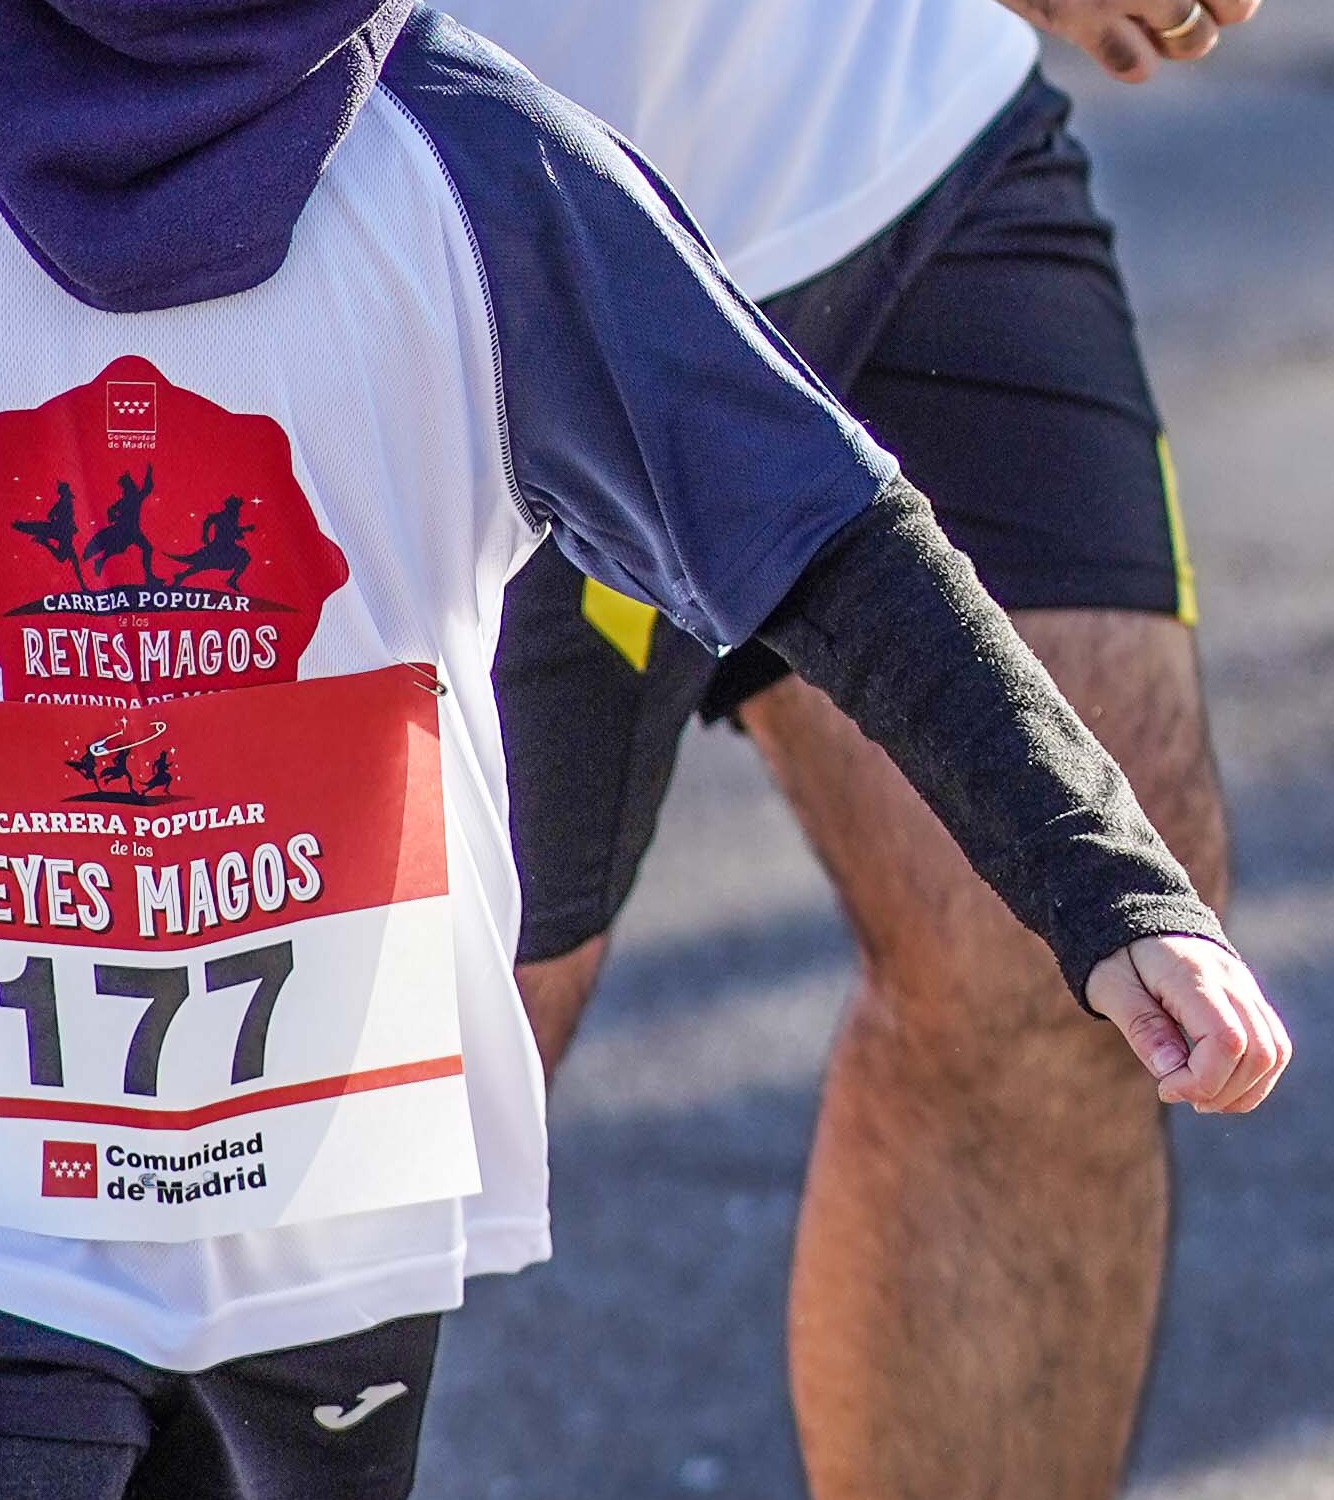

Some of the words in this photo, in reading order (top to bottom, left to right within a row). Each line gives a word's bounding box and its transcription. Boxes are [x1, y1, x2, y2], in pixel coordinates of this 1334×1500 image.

[107, 441, 120, 449] de
[122, 441, 156, 449] Madrid
[138, 591, 250, 612] POPULAR
[131, 615, 149, 628] los
[21, 627, 134, 682] REYES
[138, 625, 278, 682] MAGOS
[133, 803, 265, 839] POPULAR
[110, 840, 128, 856] de
[132, 842, 154, 857] los
[134, 833, 322, 937] MAGOS
[106, 1132, 264, 1172] Comunidad
[107, 1176, 146, 1201] de
[156, 1164, 267, 1204] Madrid
